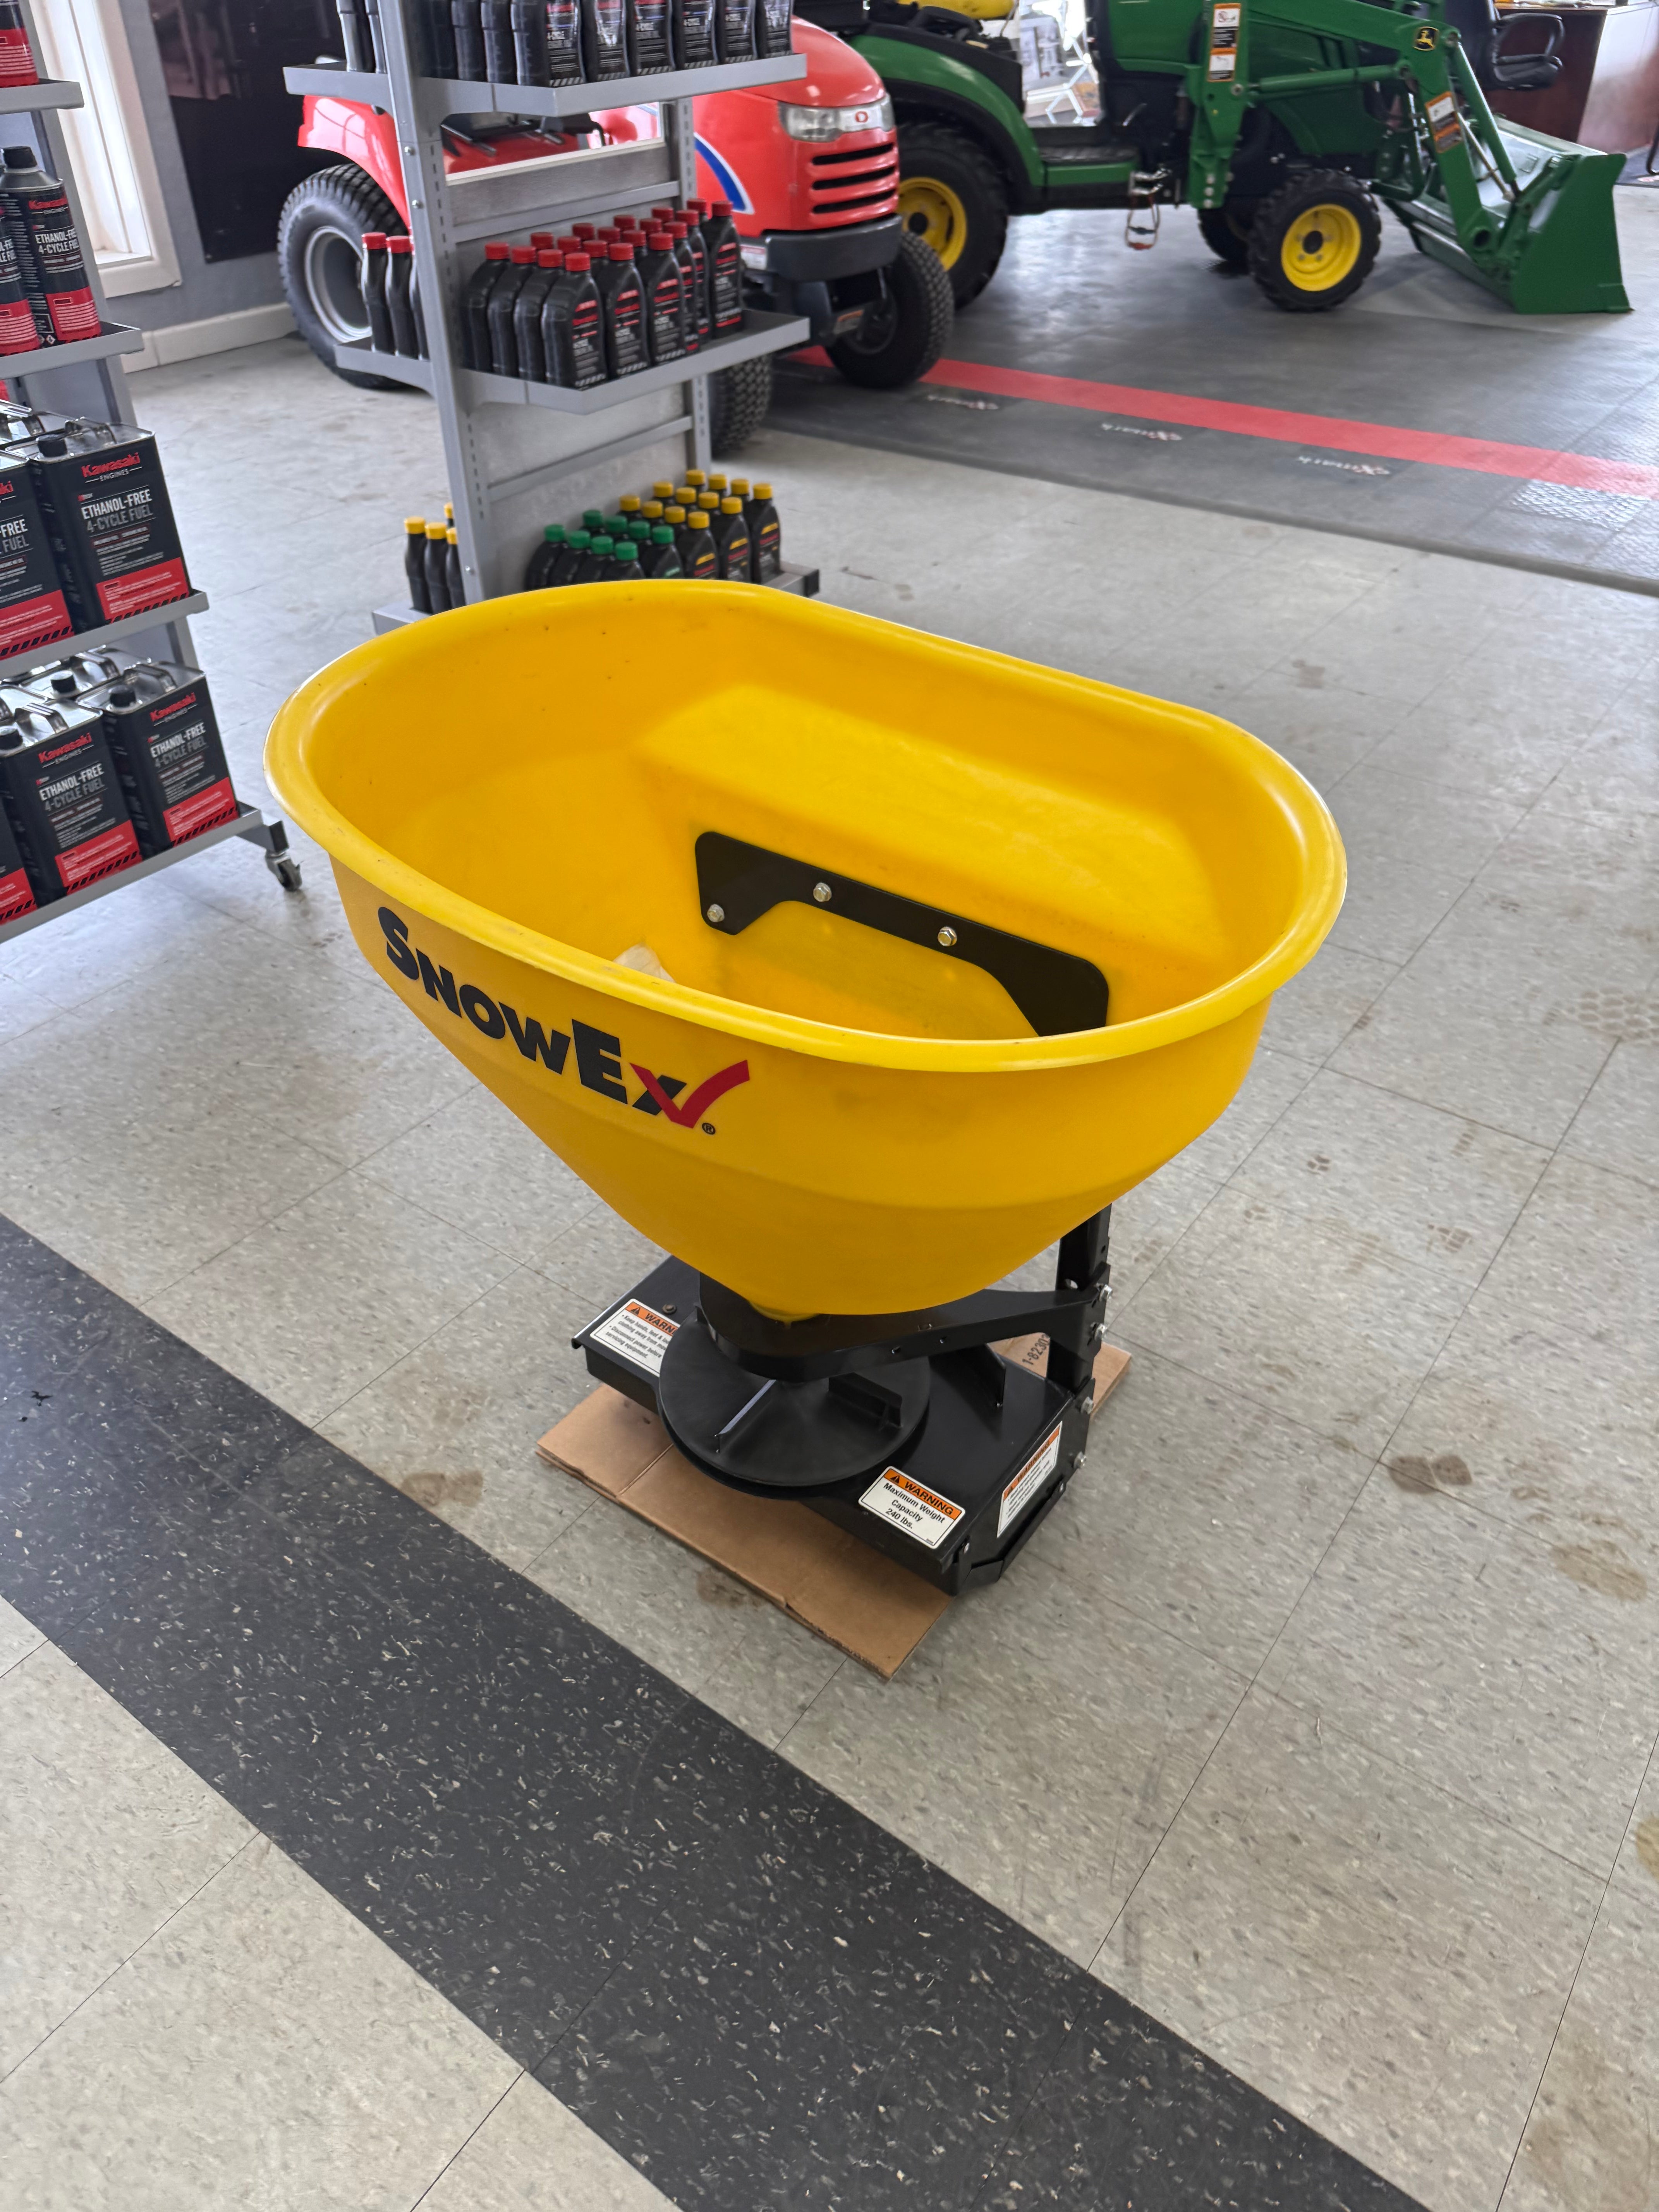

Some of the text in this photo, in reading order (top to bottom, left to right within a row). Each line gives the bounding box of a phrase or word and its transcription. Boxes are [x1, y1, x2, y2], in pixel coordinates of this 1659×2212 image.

[81, 489, 152, 520] ETHANOL-FREE
[87, 504, 153, 533] 4-CYCLE FUEL
[2, 535, 29, 553] FUEL
[150, 722, 206, 758] ETHANOL-FREE
[39, 763, 105, 801] ETHANOL-FREE
[45, 777, 105, 811] 4-CYCLE FUEL
[884, 1482, 945, 1523] Maximum Weight
[891, 1499, 923, 1522] Capacity
[905, 1481, 954, 1515] WARNING
[886, 1508, 913, 1529] 240 lbs.
